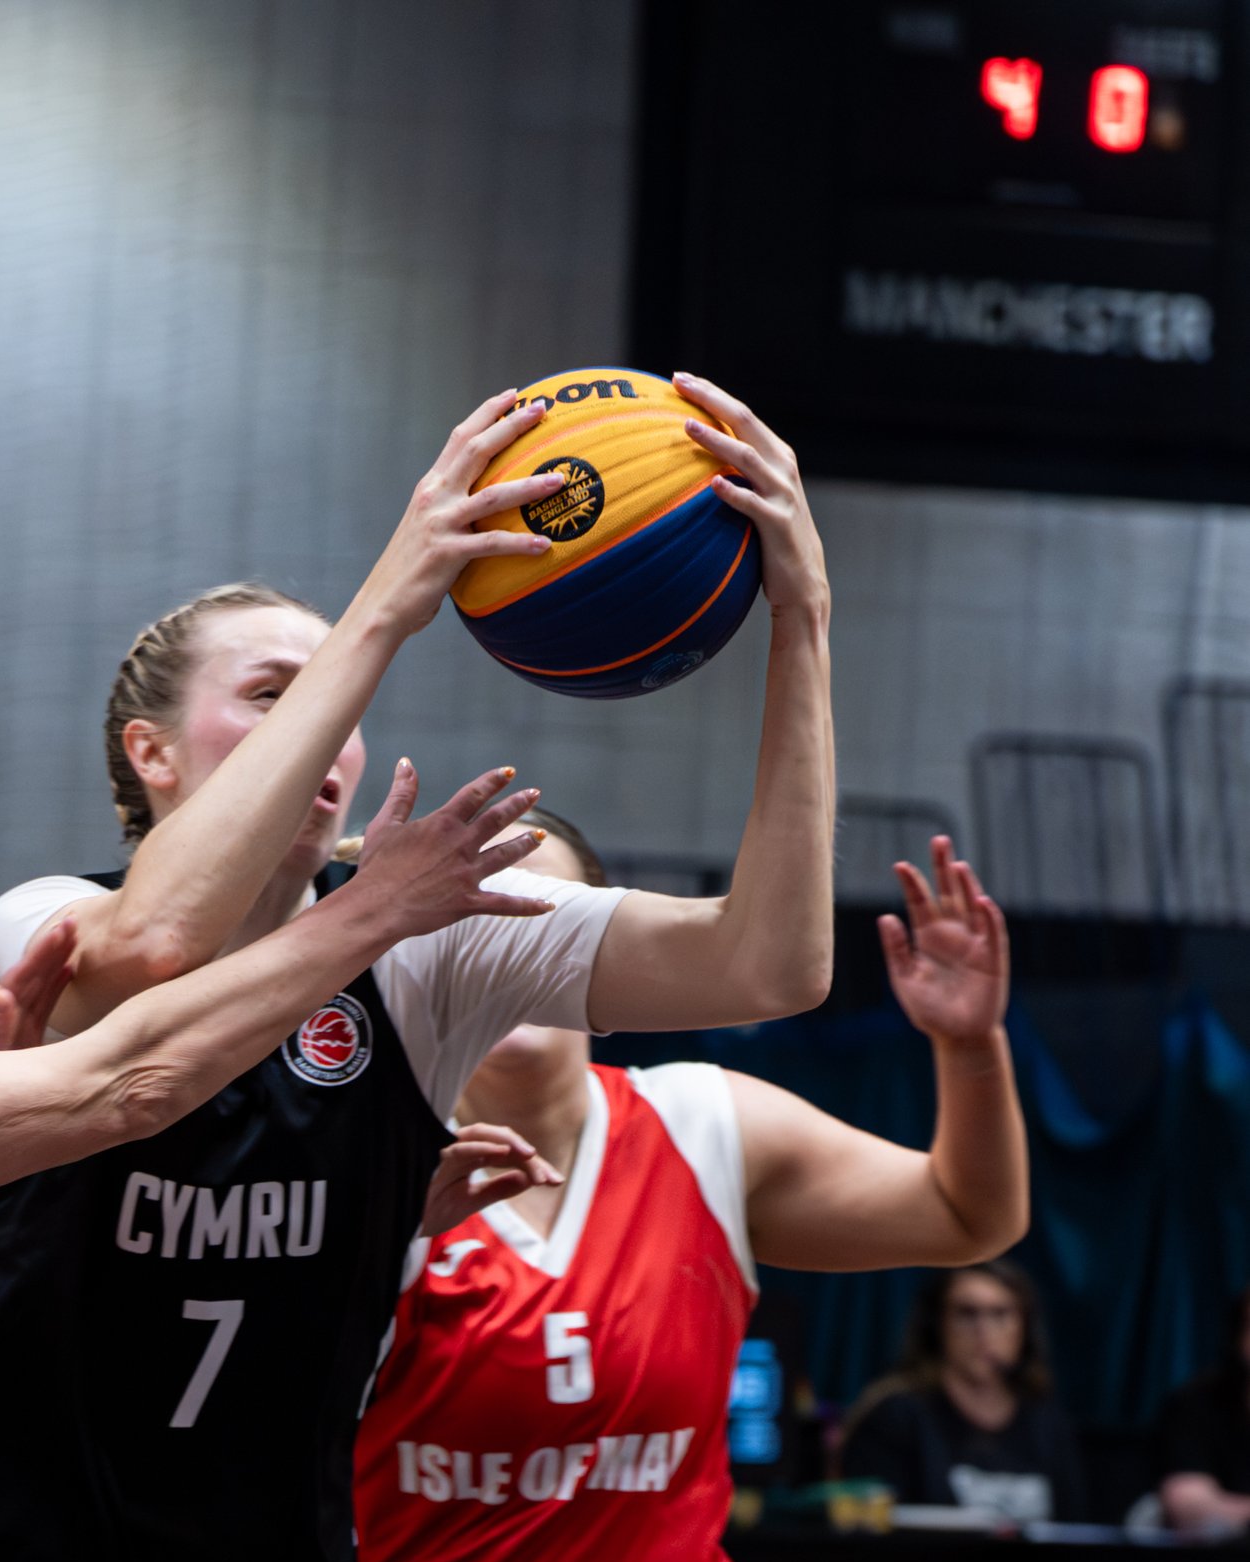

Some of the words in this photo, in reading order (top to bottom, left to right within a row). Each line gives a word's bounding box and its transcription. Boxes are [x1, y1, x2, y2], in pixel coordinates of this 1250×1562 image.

[981, 56, 1042, 140] 4
[1087, 64, 1149, 152] 0
[846, 271, 1213, 362] MANCHESTER
[529, 478, 599, 520] BASKETBALL
[541, 489, 590, 522] ENGLAND
[115, 1171, 327, 1259] CYMRU
[169, 1299, 245, 1428] 7
[543, 1311, 594, 1404] 5
[397, 1441, 513, 1505] ISLE
[518, 1443, 596, 1501] OF
